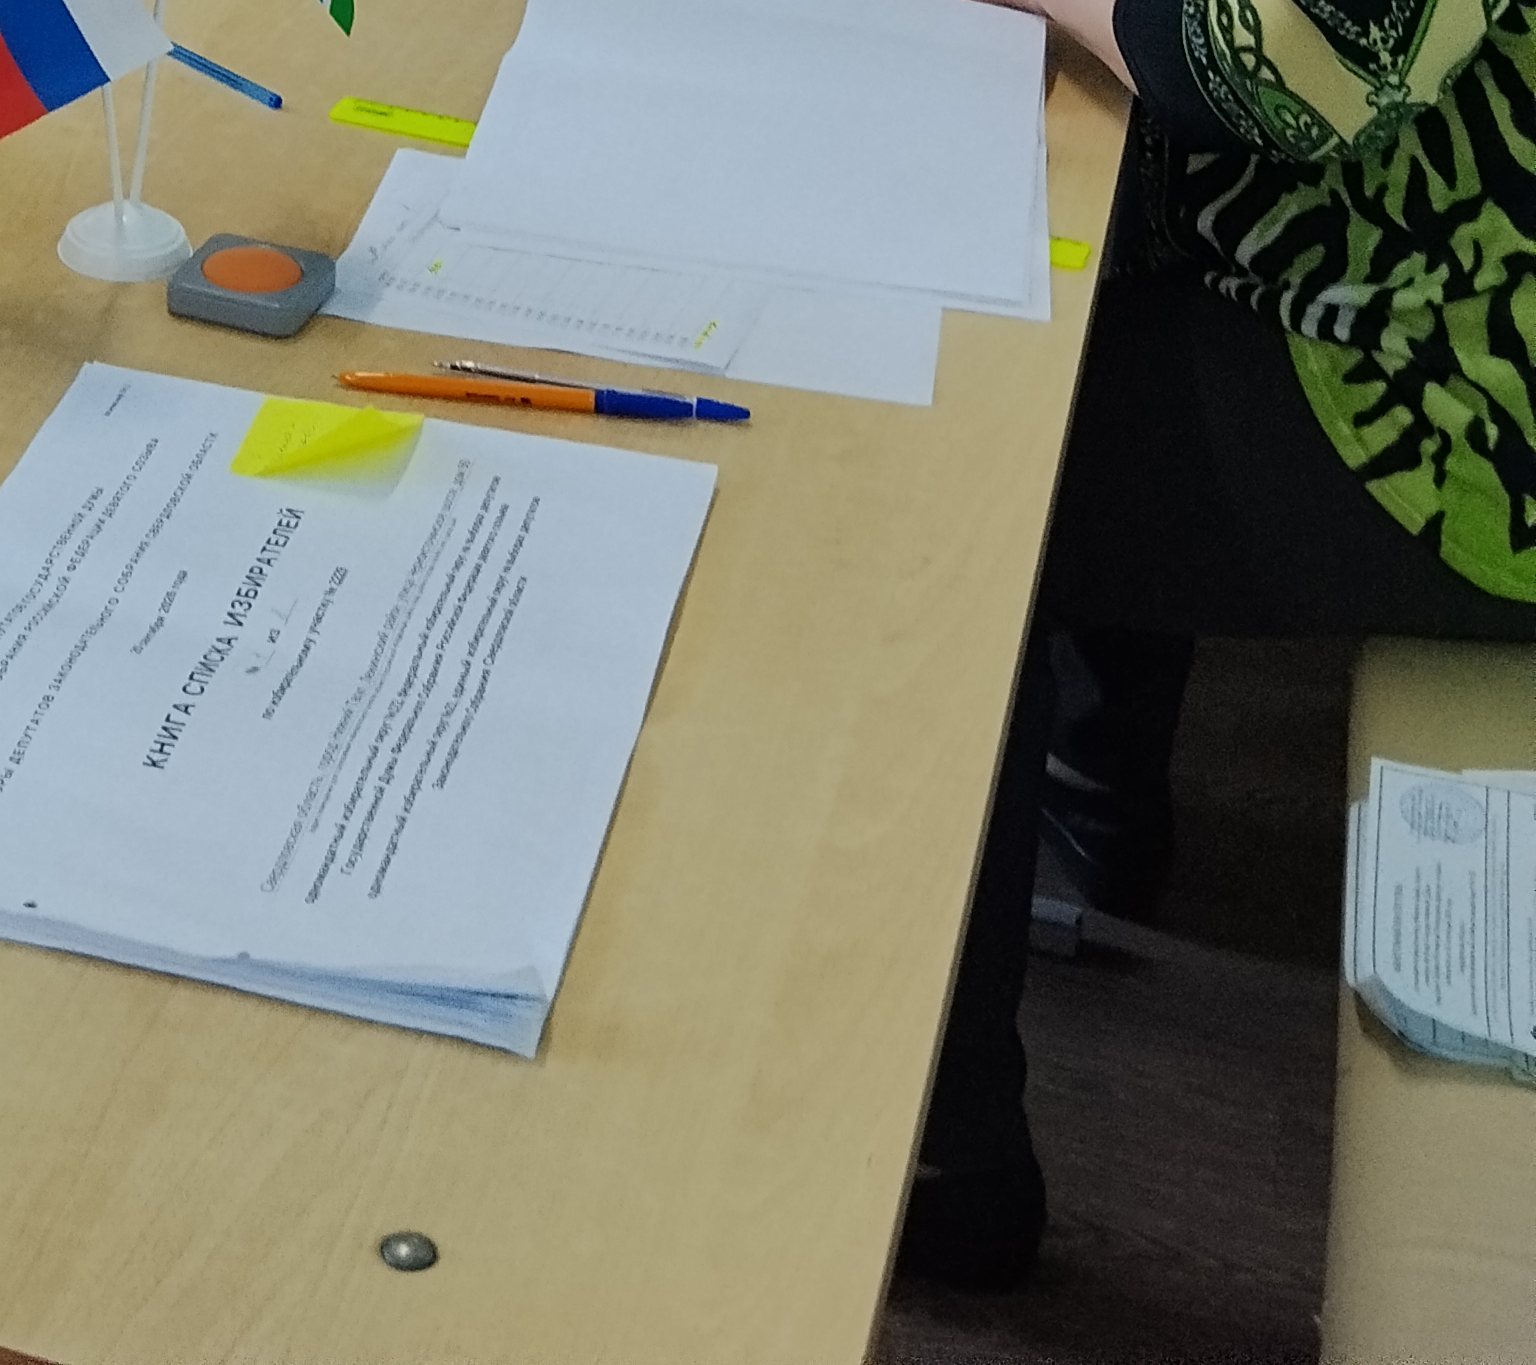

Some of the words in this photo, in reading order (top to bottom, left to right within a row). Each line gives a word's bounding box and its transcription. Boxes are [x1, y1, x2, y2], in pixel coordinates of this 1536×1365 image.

[8, 694, 56, 766] ДЕПУТАТОВ
[47, 596, 120, 692] ЗАКОНОДАТЕЛЬНОГО
[112, 540, 151, 594] СОБРАНИЯ
[144, 472, 194, 539] СВЕРДЛОВСКОЙ
[188, 431, 219, 471] ОБЛАСТИ
[20, 511, 87, 604] ГОСУДАРСТВЕННОЙ
[23, 575, 71, 633] РОССИЙСКОЙ
[66, 517, 106, 573] ФЕДЕРАЦИИ
[101, 473, 138, 519] ДЕВЯТОГО
[131, 437, 160, 473] СОЗЫВА
[142, 703, 196, 770] КНИГА
[181, 636, 239, 697] СПИСКА
[222, 507, 305, 628] ИЗБИРАТЕЛЕЙ
